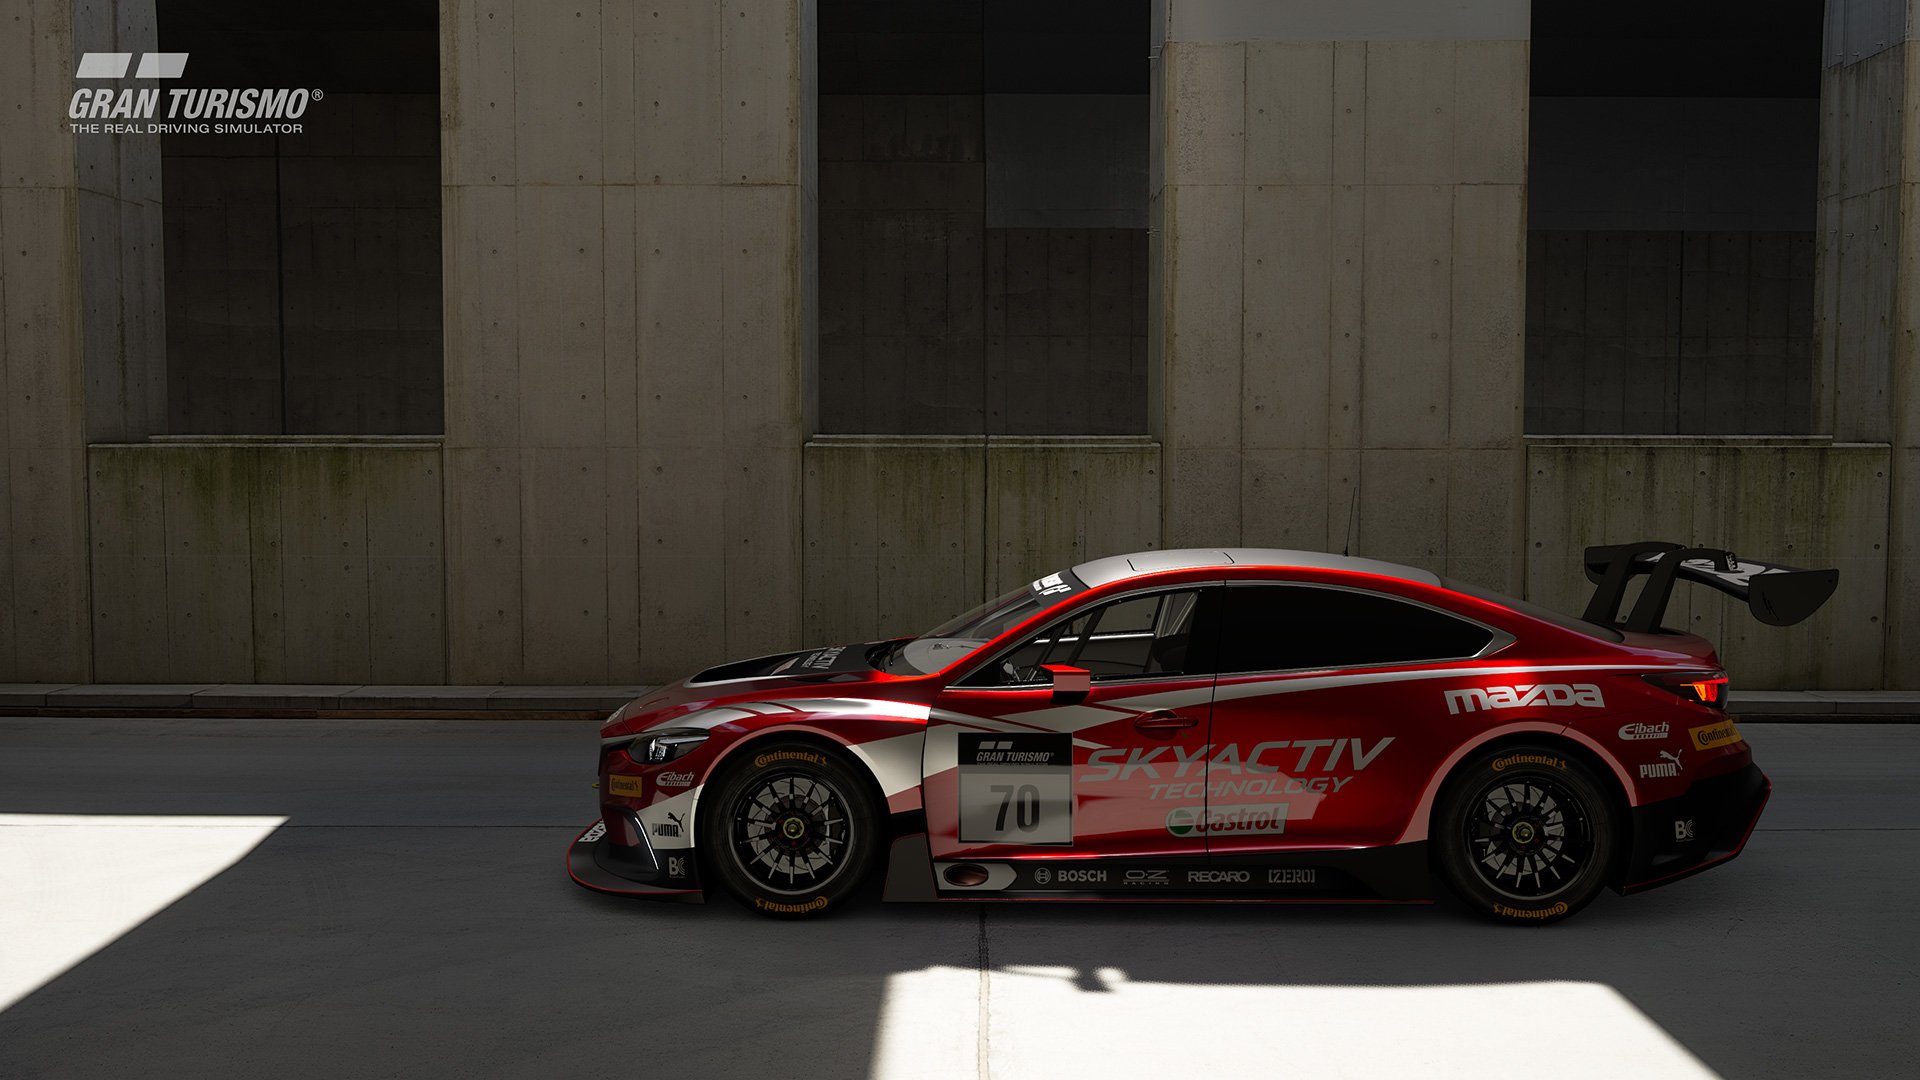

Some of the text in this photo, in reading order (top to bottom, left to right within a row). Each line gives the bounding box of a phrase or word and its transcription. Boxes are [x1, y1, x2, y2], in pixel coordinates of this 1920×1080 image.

[1617, 721, 1670, 741] Eibach
[754, 750, 820, 769] Continental
[976, 751, 1005, 762] GRAN
[1079, 736, 1397, 783] SKYACTIV
[1491, 753, 1559, 772] Continental
[655, 771, 696, 787] Eibach
[1639, 762, 1680, 779] PUMA
[1149, 775, 1354, 801] TECHNOLOGY
[990, 784, 1040, 833] 70
[1195, 806, 1280, 832] Castrol
[652, 822, 680, 837] PUMA
[1057, 869, 1108, 883] BOSCH
[1187, 870, 1251, 883] RECARO
[763, 895, 830, 914] Continental
[1501, 901, 1570, 920] Continental
